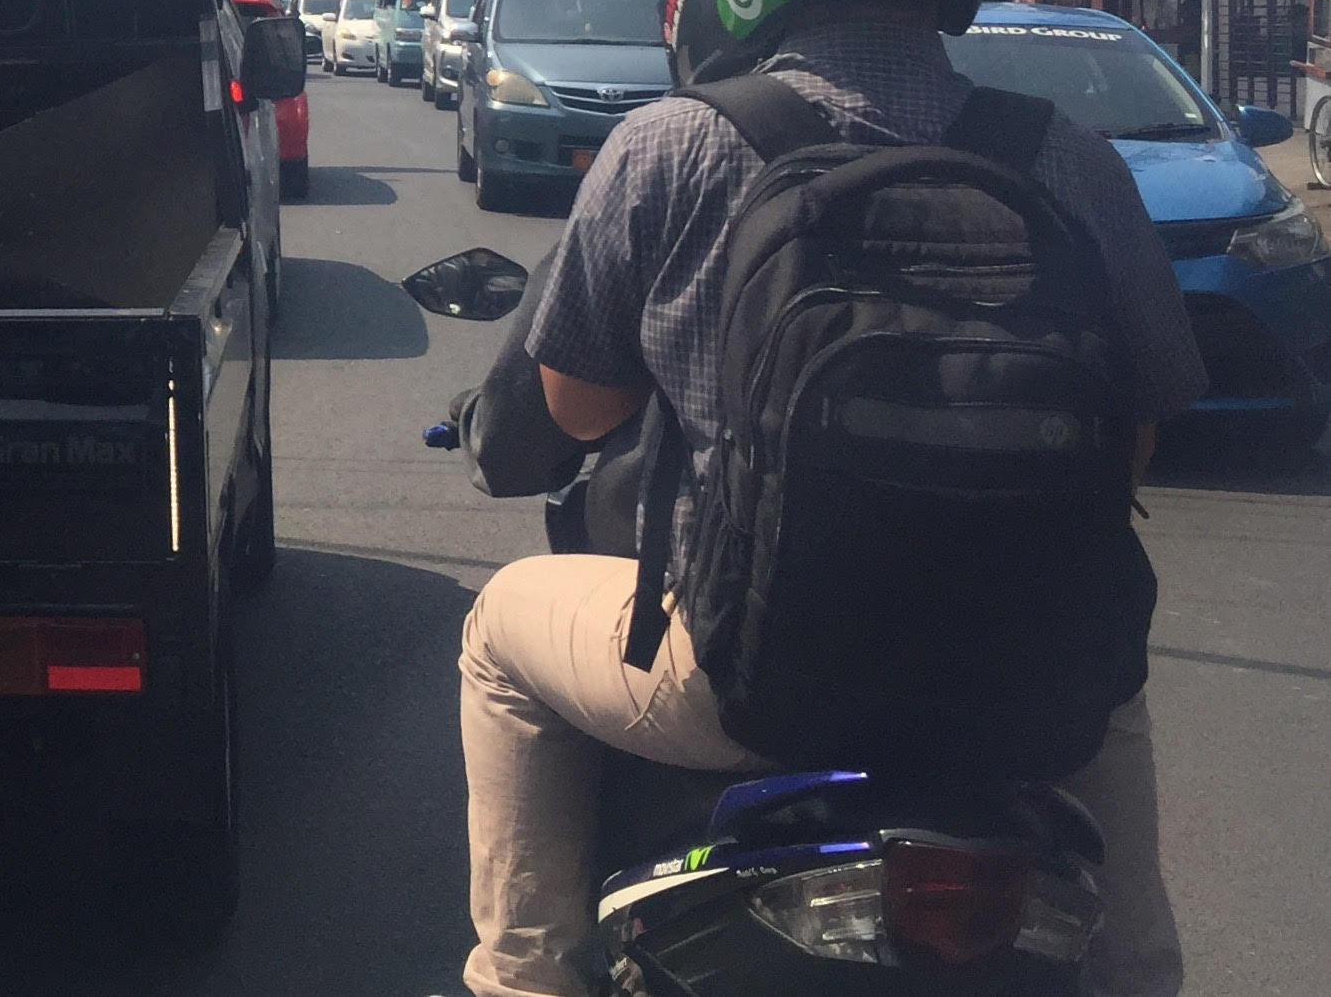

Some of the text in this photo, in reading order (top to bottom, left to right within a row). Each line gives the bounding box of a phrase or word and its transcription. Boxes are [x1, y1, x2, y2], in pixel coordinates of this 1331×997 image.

[966, 24, 1123, 42] BIRD GROUP
[67, 435, 137, 464] Max
